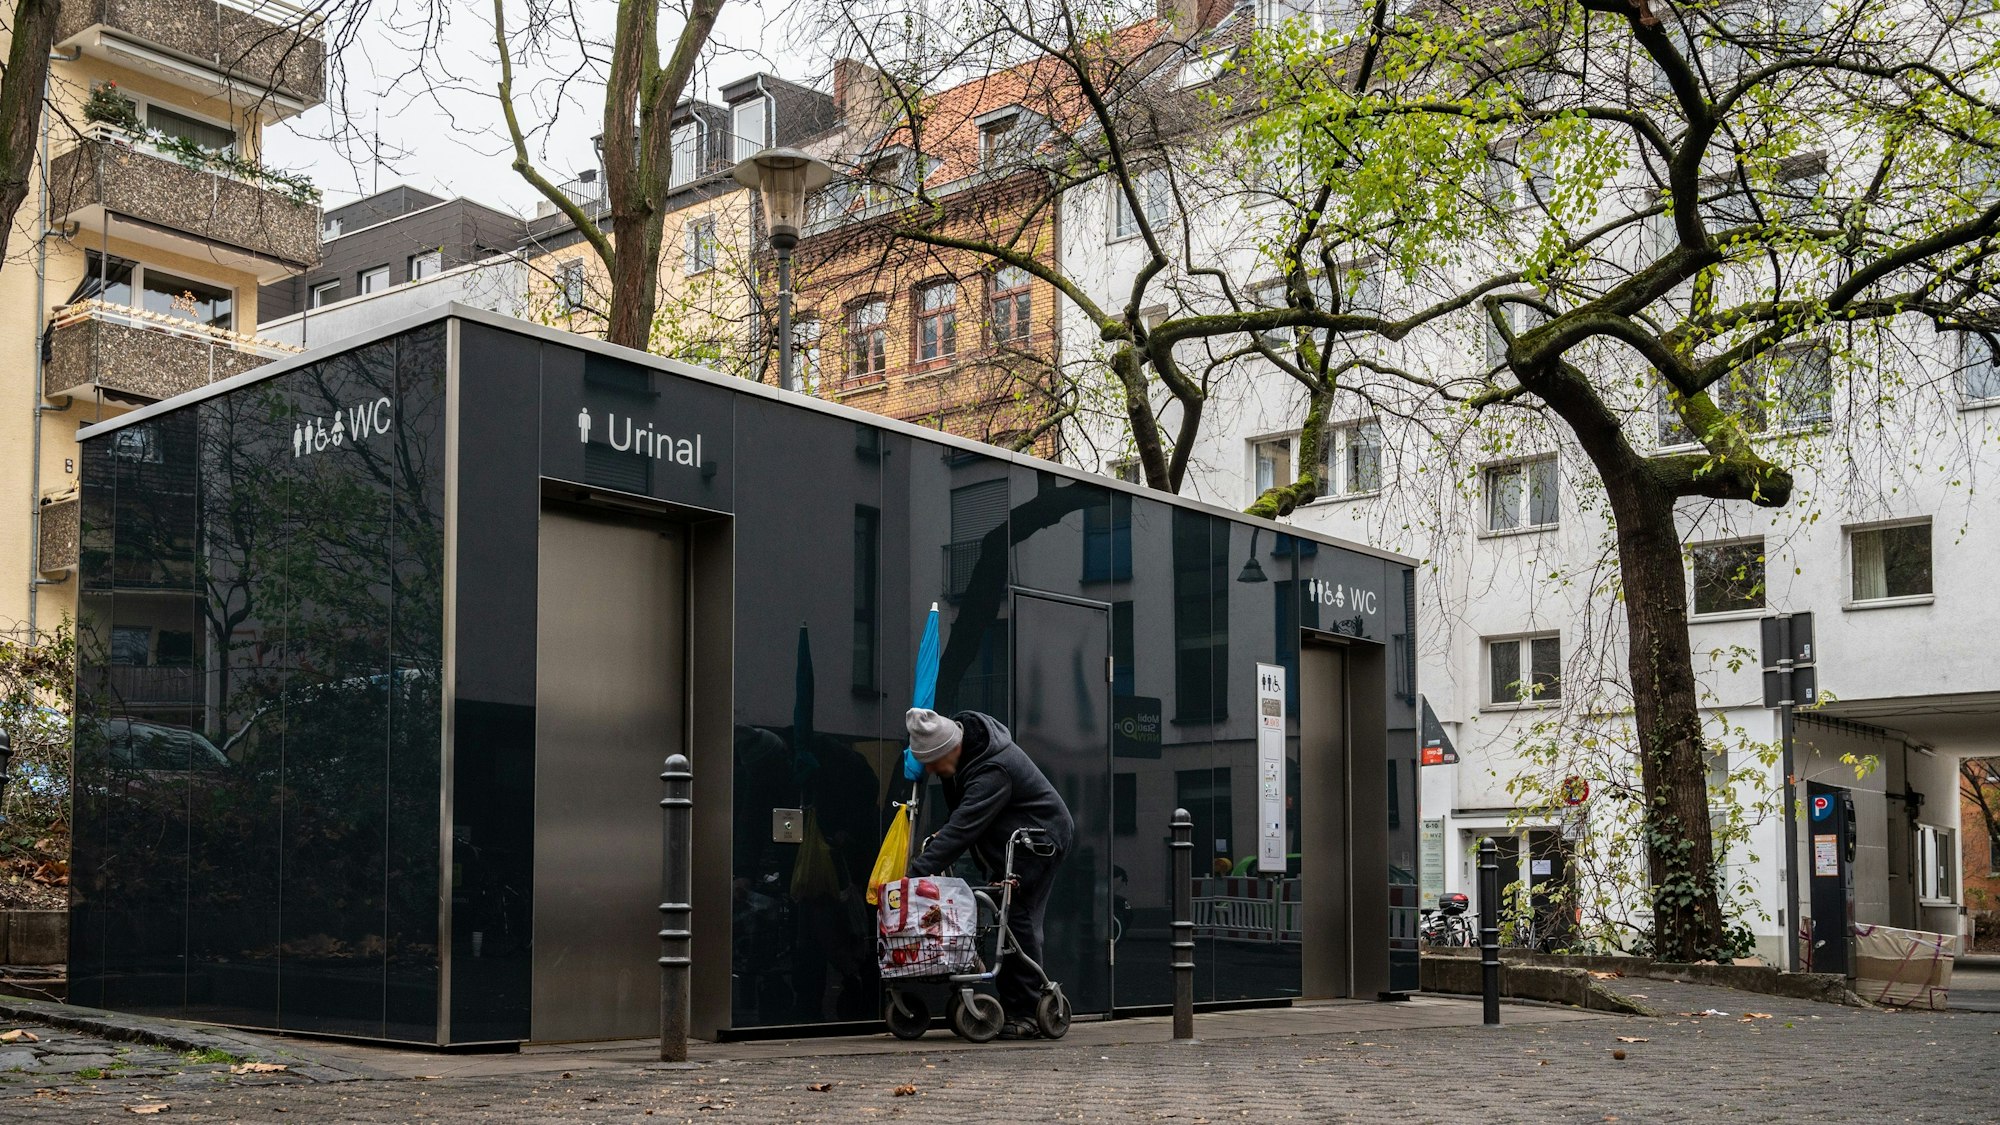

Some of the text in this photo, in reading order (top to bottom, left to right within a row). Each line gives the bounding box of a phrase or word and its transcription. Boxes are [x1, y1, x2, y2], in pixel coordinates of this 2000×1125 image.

[349, 397, 391, 442] WC
[608, 413, 702, 467] Urinal
[1350, 587, 1377, 615] WC
[1815, 797, 1828, 816] P
